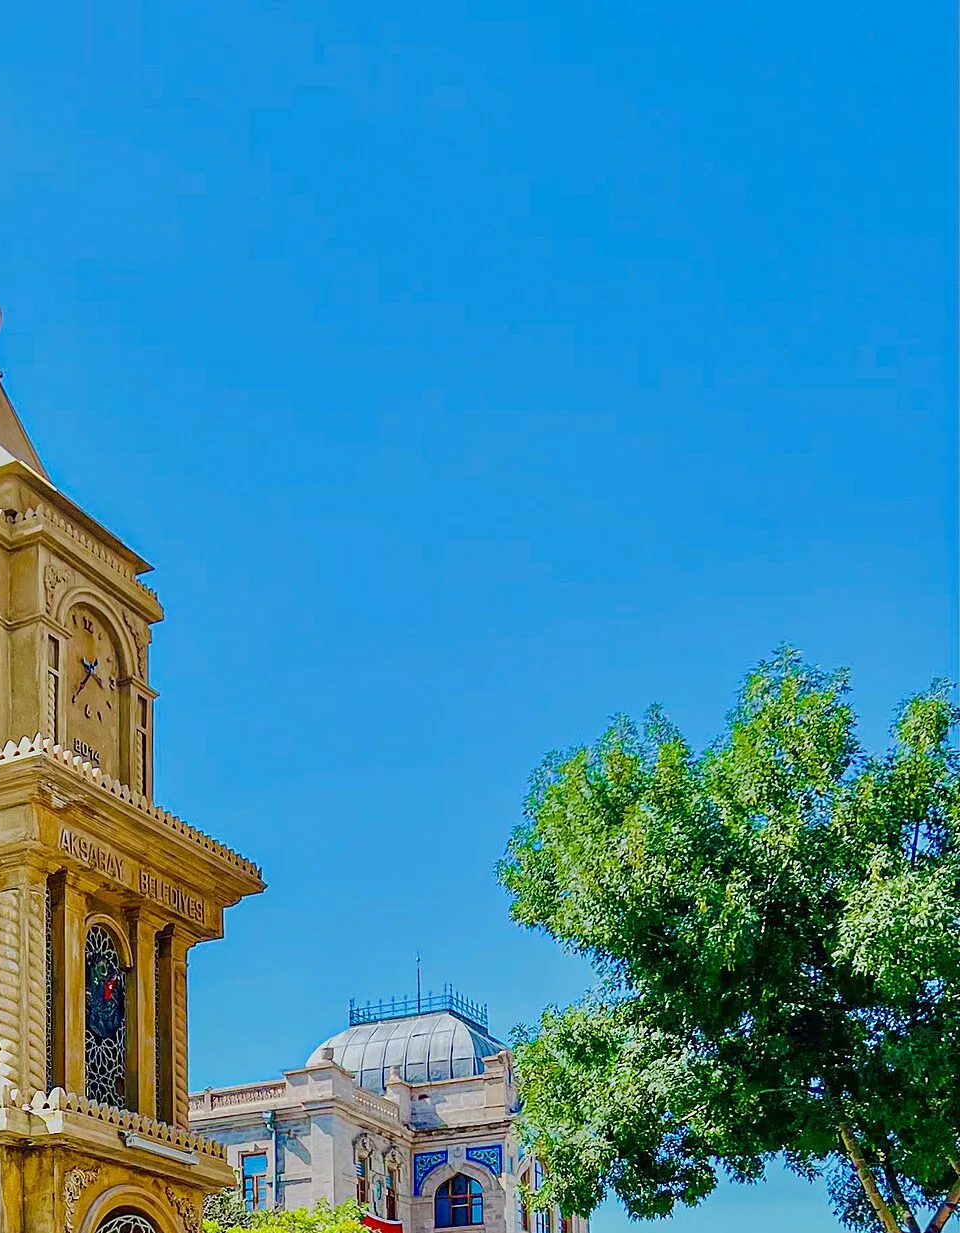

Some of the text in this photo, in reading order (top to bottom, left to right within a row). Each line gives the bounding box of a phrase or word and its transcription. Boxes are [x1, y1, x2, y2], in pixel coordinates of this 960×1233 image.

[83, 616, 94, 634] 12
[73, 737, 101, 765] 2014
[58, 828, 124, 882] AKSARAY
